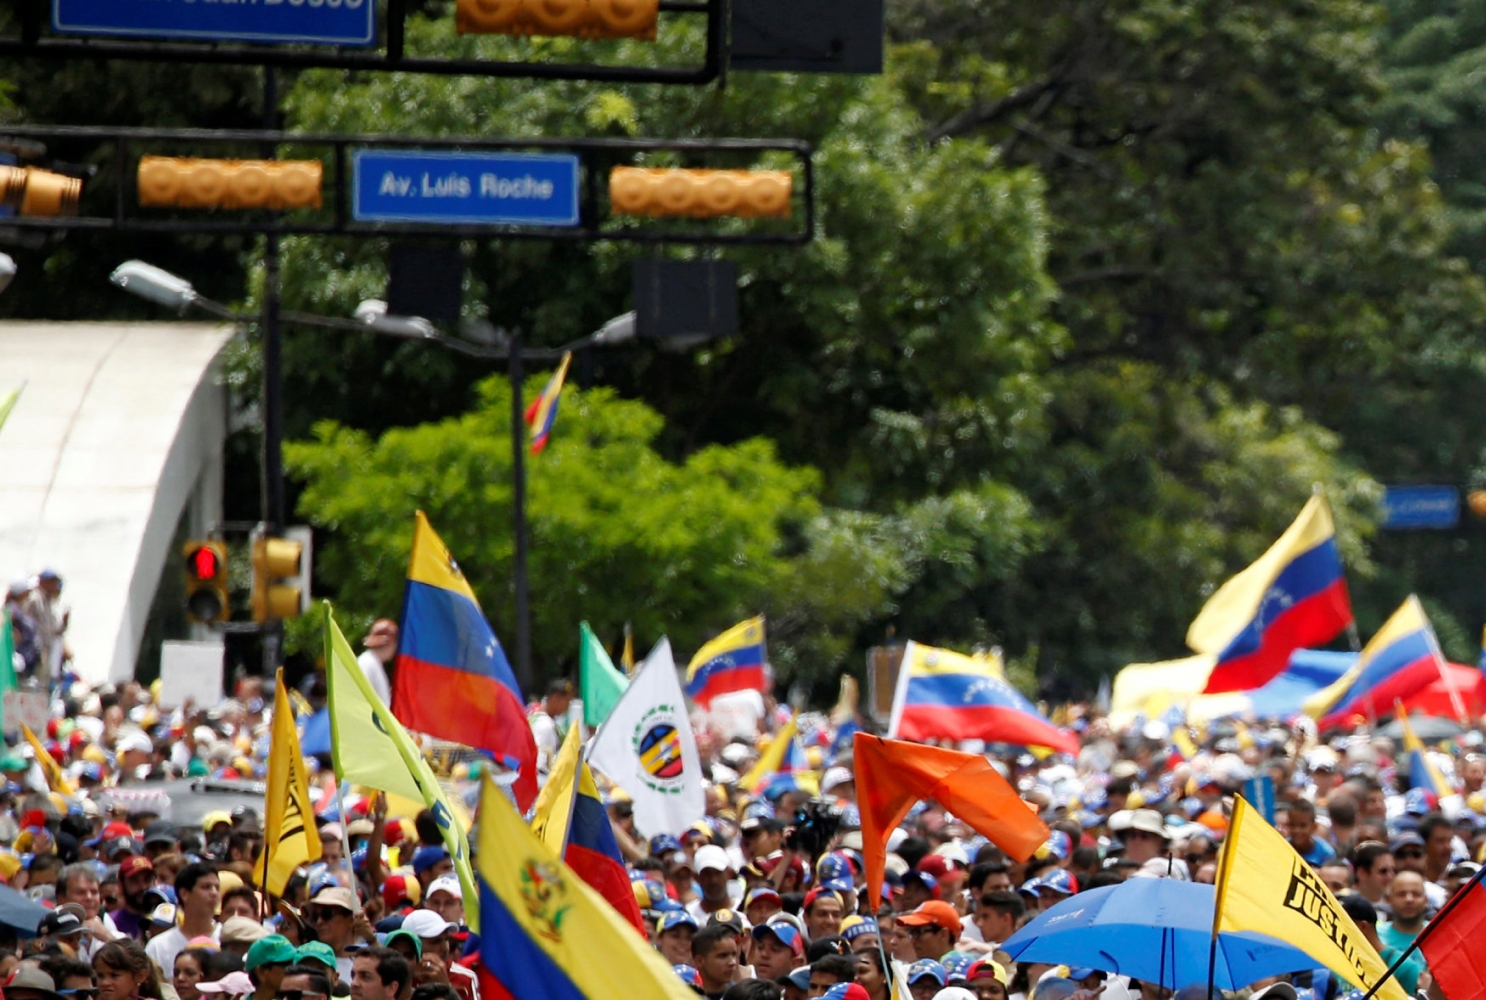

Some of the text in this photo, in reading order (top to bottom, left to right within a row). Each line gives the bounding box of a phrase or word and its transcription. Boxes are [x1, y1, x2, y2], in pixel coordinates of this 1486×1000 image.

[379, 170, 554, 200] Av. Luis Roche
